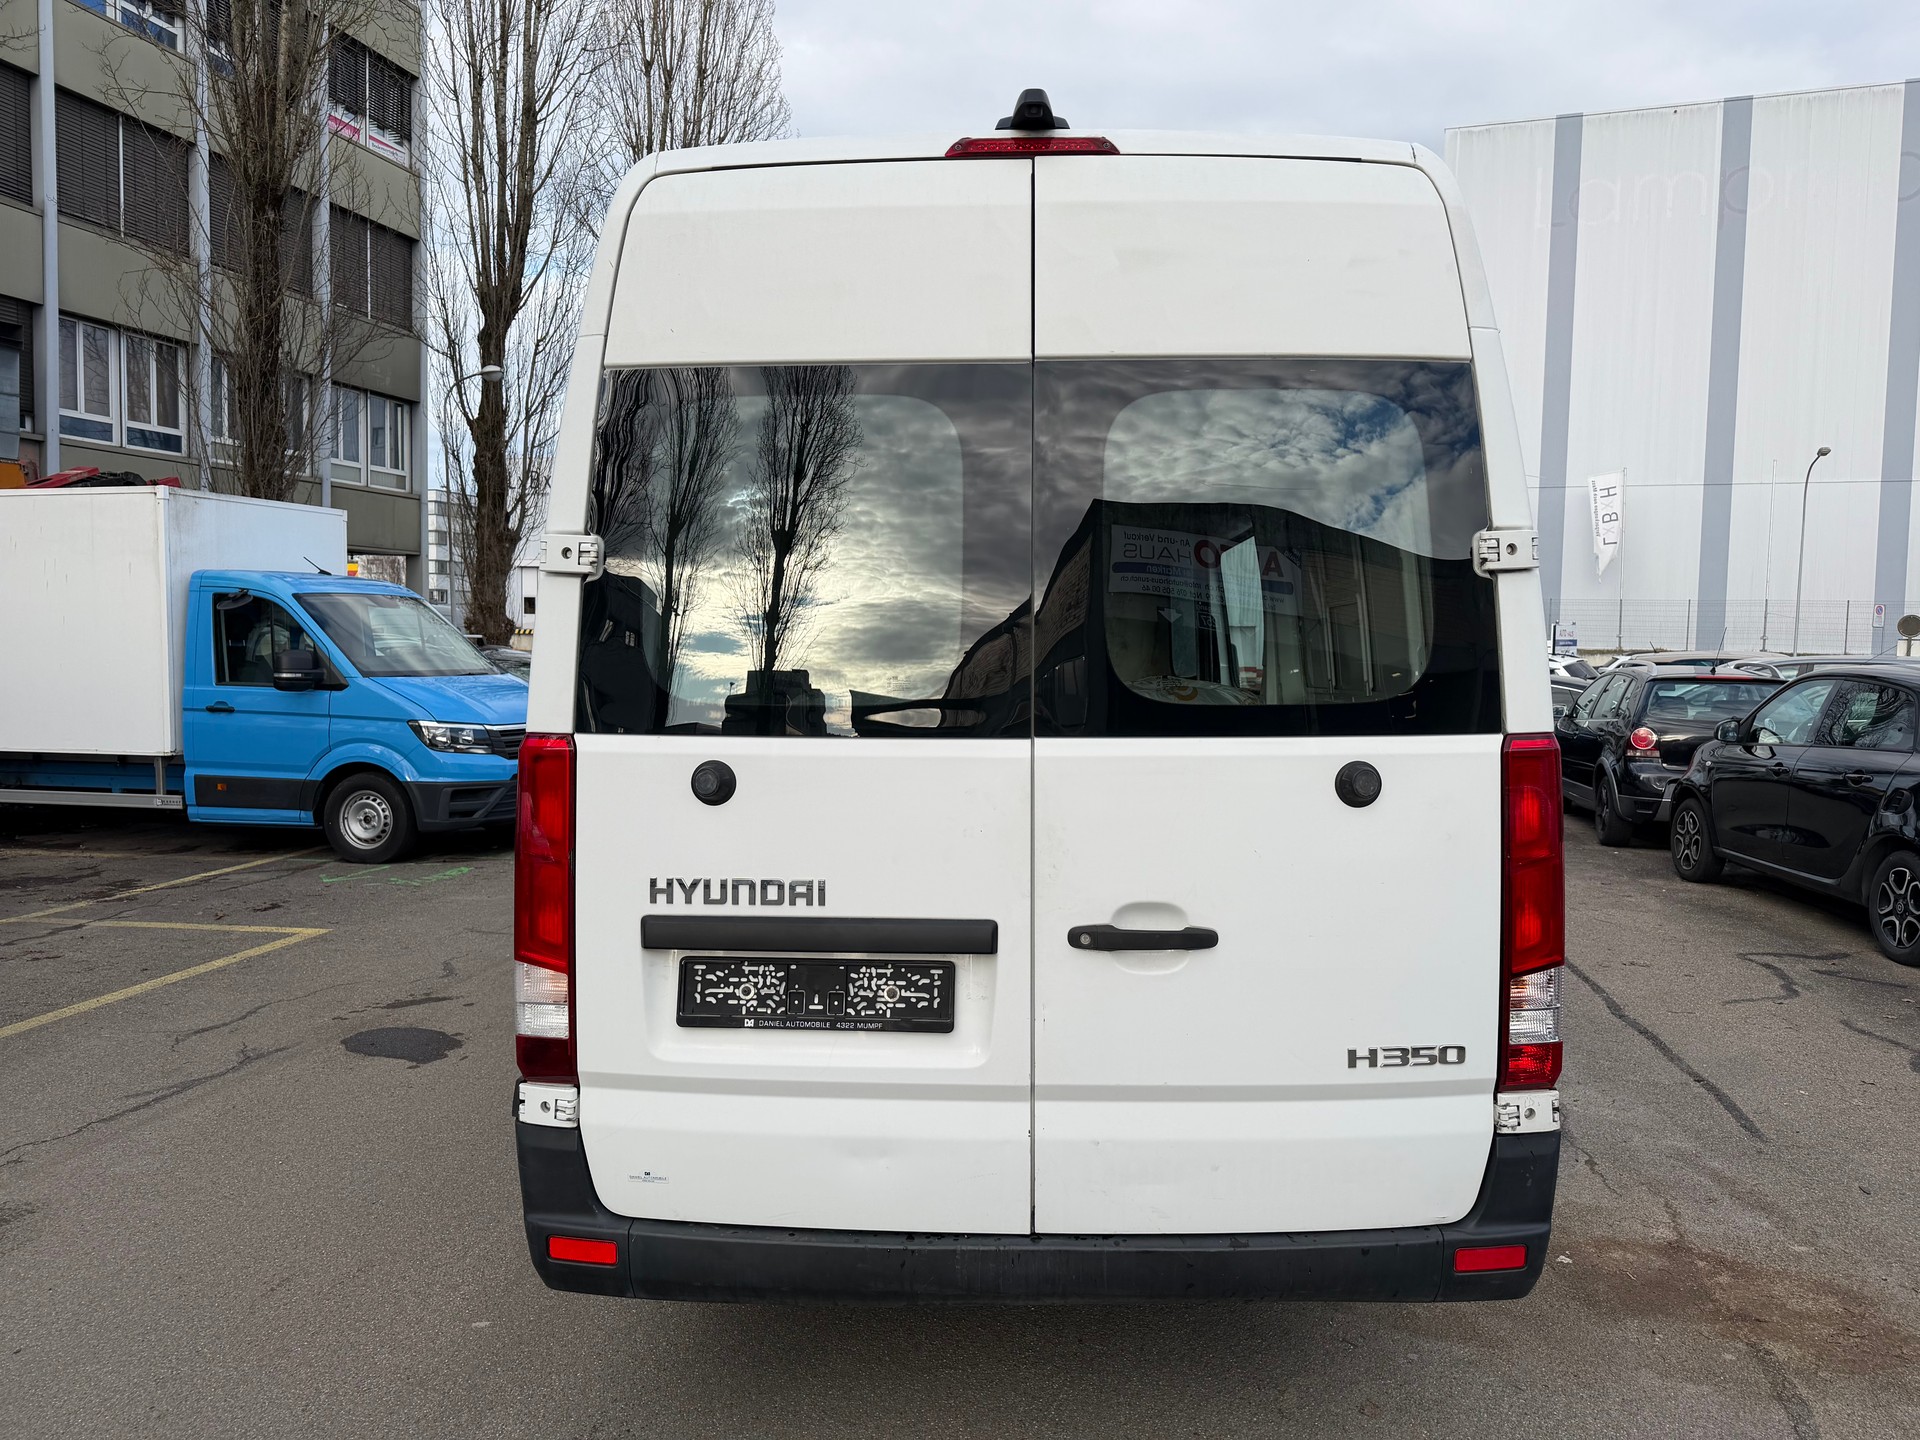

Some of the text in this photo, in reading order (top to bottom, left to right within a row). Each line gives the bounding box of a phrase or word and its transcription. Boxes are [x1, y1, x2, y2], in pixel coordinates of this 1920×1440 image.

[649, 877, 826, 907] HYUNDAI
[758, 1019, 784, 1027] DANIEL
[785, 1020, 830, 1028] AUTOMOBILE
[857, 1022, 883, 1030] MUMPF
[1347, 1043, 1466, 1069] H350
